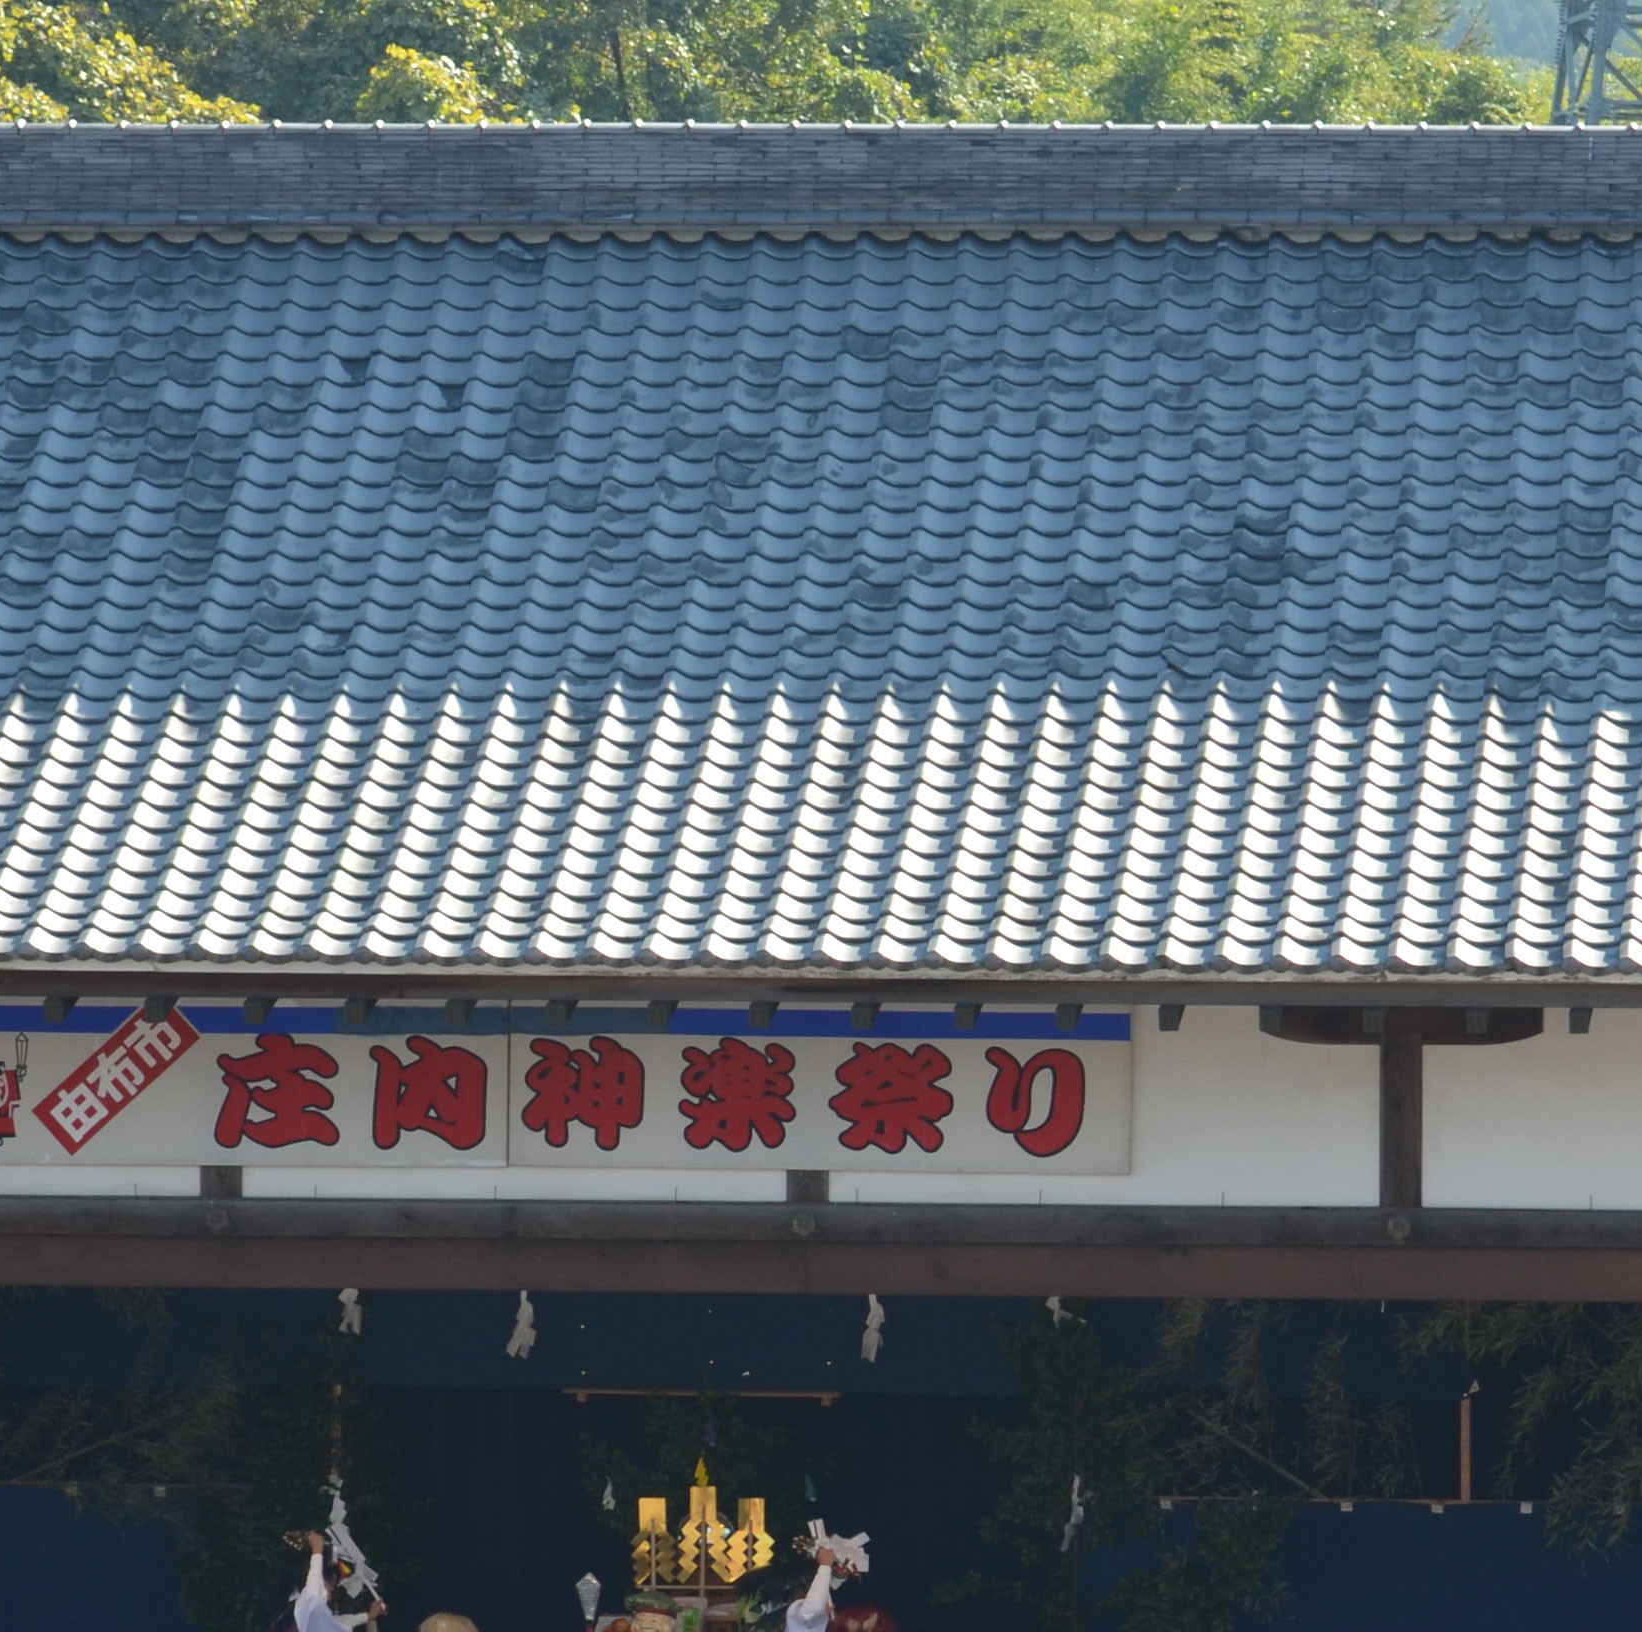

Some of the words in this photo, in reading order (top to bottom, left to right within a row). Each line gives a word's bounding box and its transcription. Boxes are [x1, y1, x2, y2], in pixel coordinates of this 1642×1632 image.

[49, 1018, 182, 1143] 由布市
[213, 1034, 1089, 1156] 庄内神楽祭り
